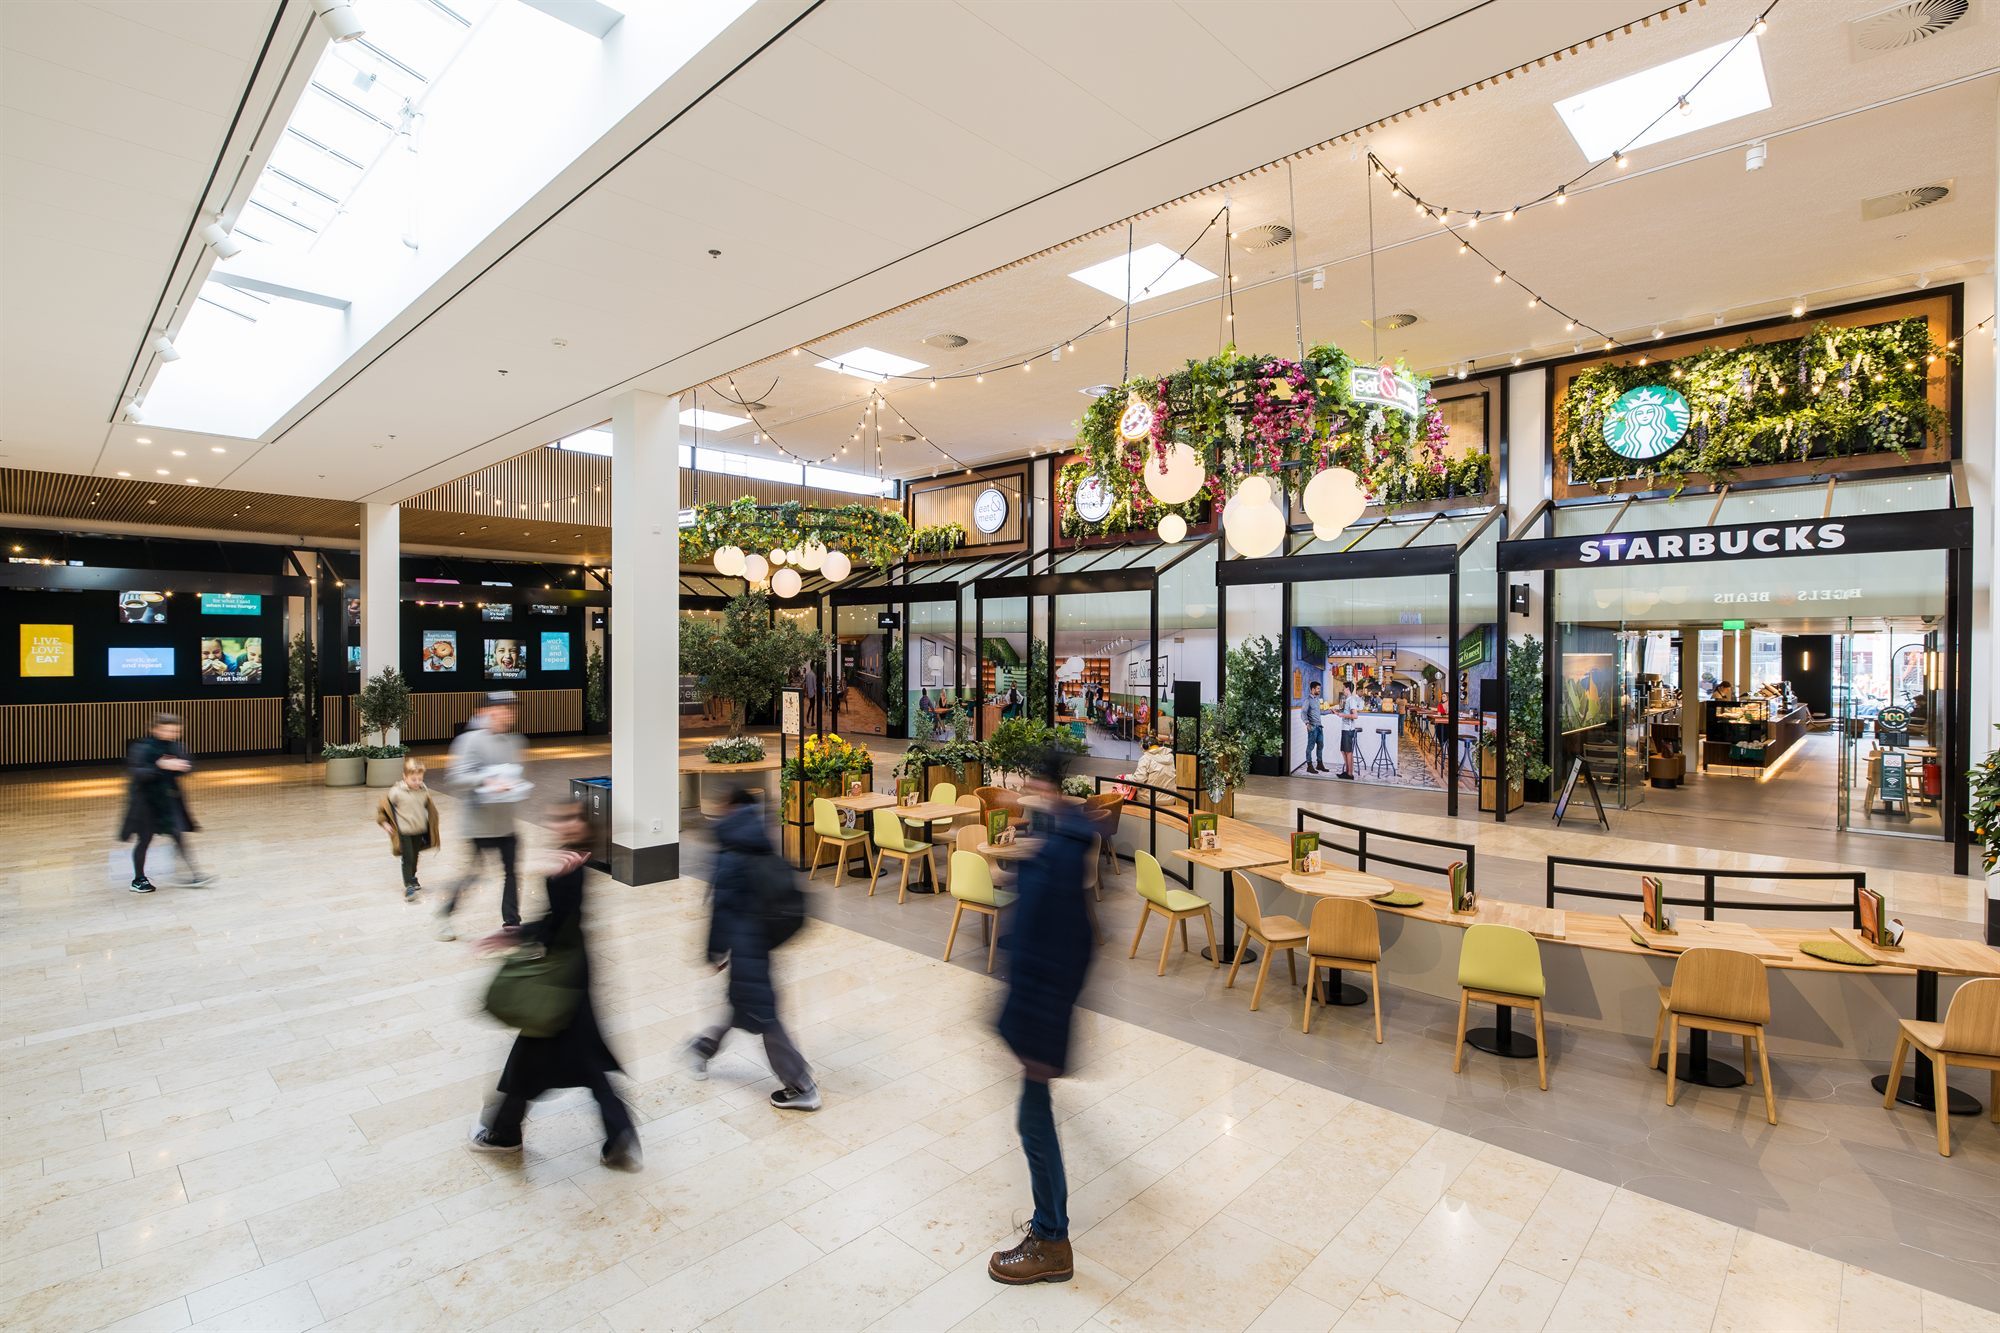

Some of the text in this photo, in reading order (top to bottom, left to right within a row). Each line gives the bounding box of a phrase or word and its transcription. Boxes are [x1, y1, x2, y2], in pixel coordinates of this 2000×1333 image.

[1355, 376, 1380, 394] eat
[1378, 364, 1399, 399] &
[978, 494, 1002, 513] eat &
[1080, 500, 1103, 509] mee
[978, 513, 997, 522] meet
[1579, 523, 1846, 562] STARBUCKS
[35, 655, 60, 663] EAT
[544, 656, 567, 664] repeat
[1882, 712, 1905, 721] 100
